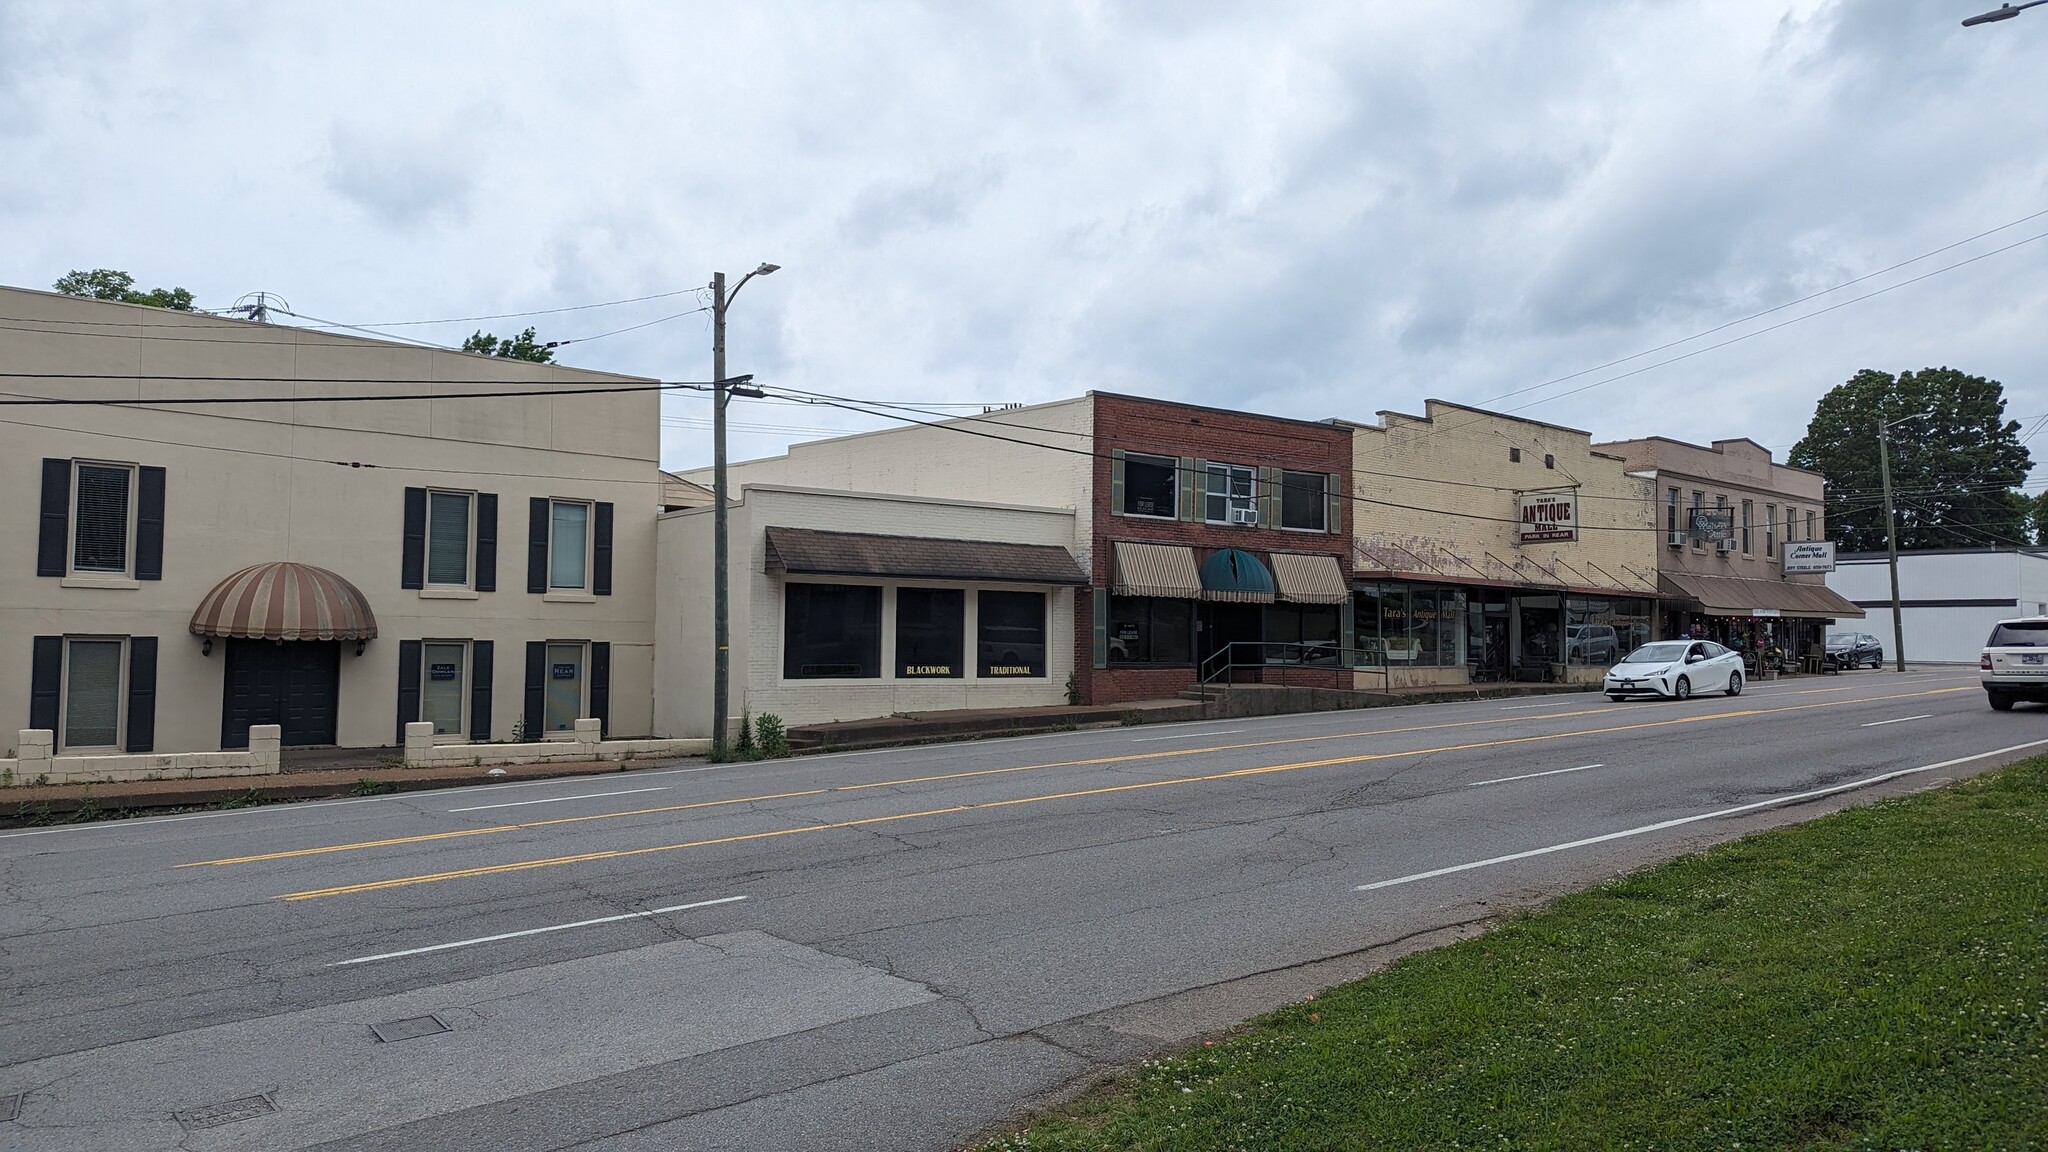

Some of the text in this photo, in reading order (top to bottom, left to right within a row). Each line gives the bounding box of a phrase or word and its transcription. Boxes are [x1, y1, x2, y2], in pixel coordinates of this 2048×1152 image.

[1522, 502, 1571, 523] ANTIQUE
[1534, 524, 1558, 532] MALL
[1383, 607, 1456, 620] Tara's Antique Mall
[906, 665, 950, 674] BLACKWORK
[989, 666, 1031, 674] TRADITIONAL
